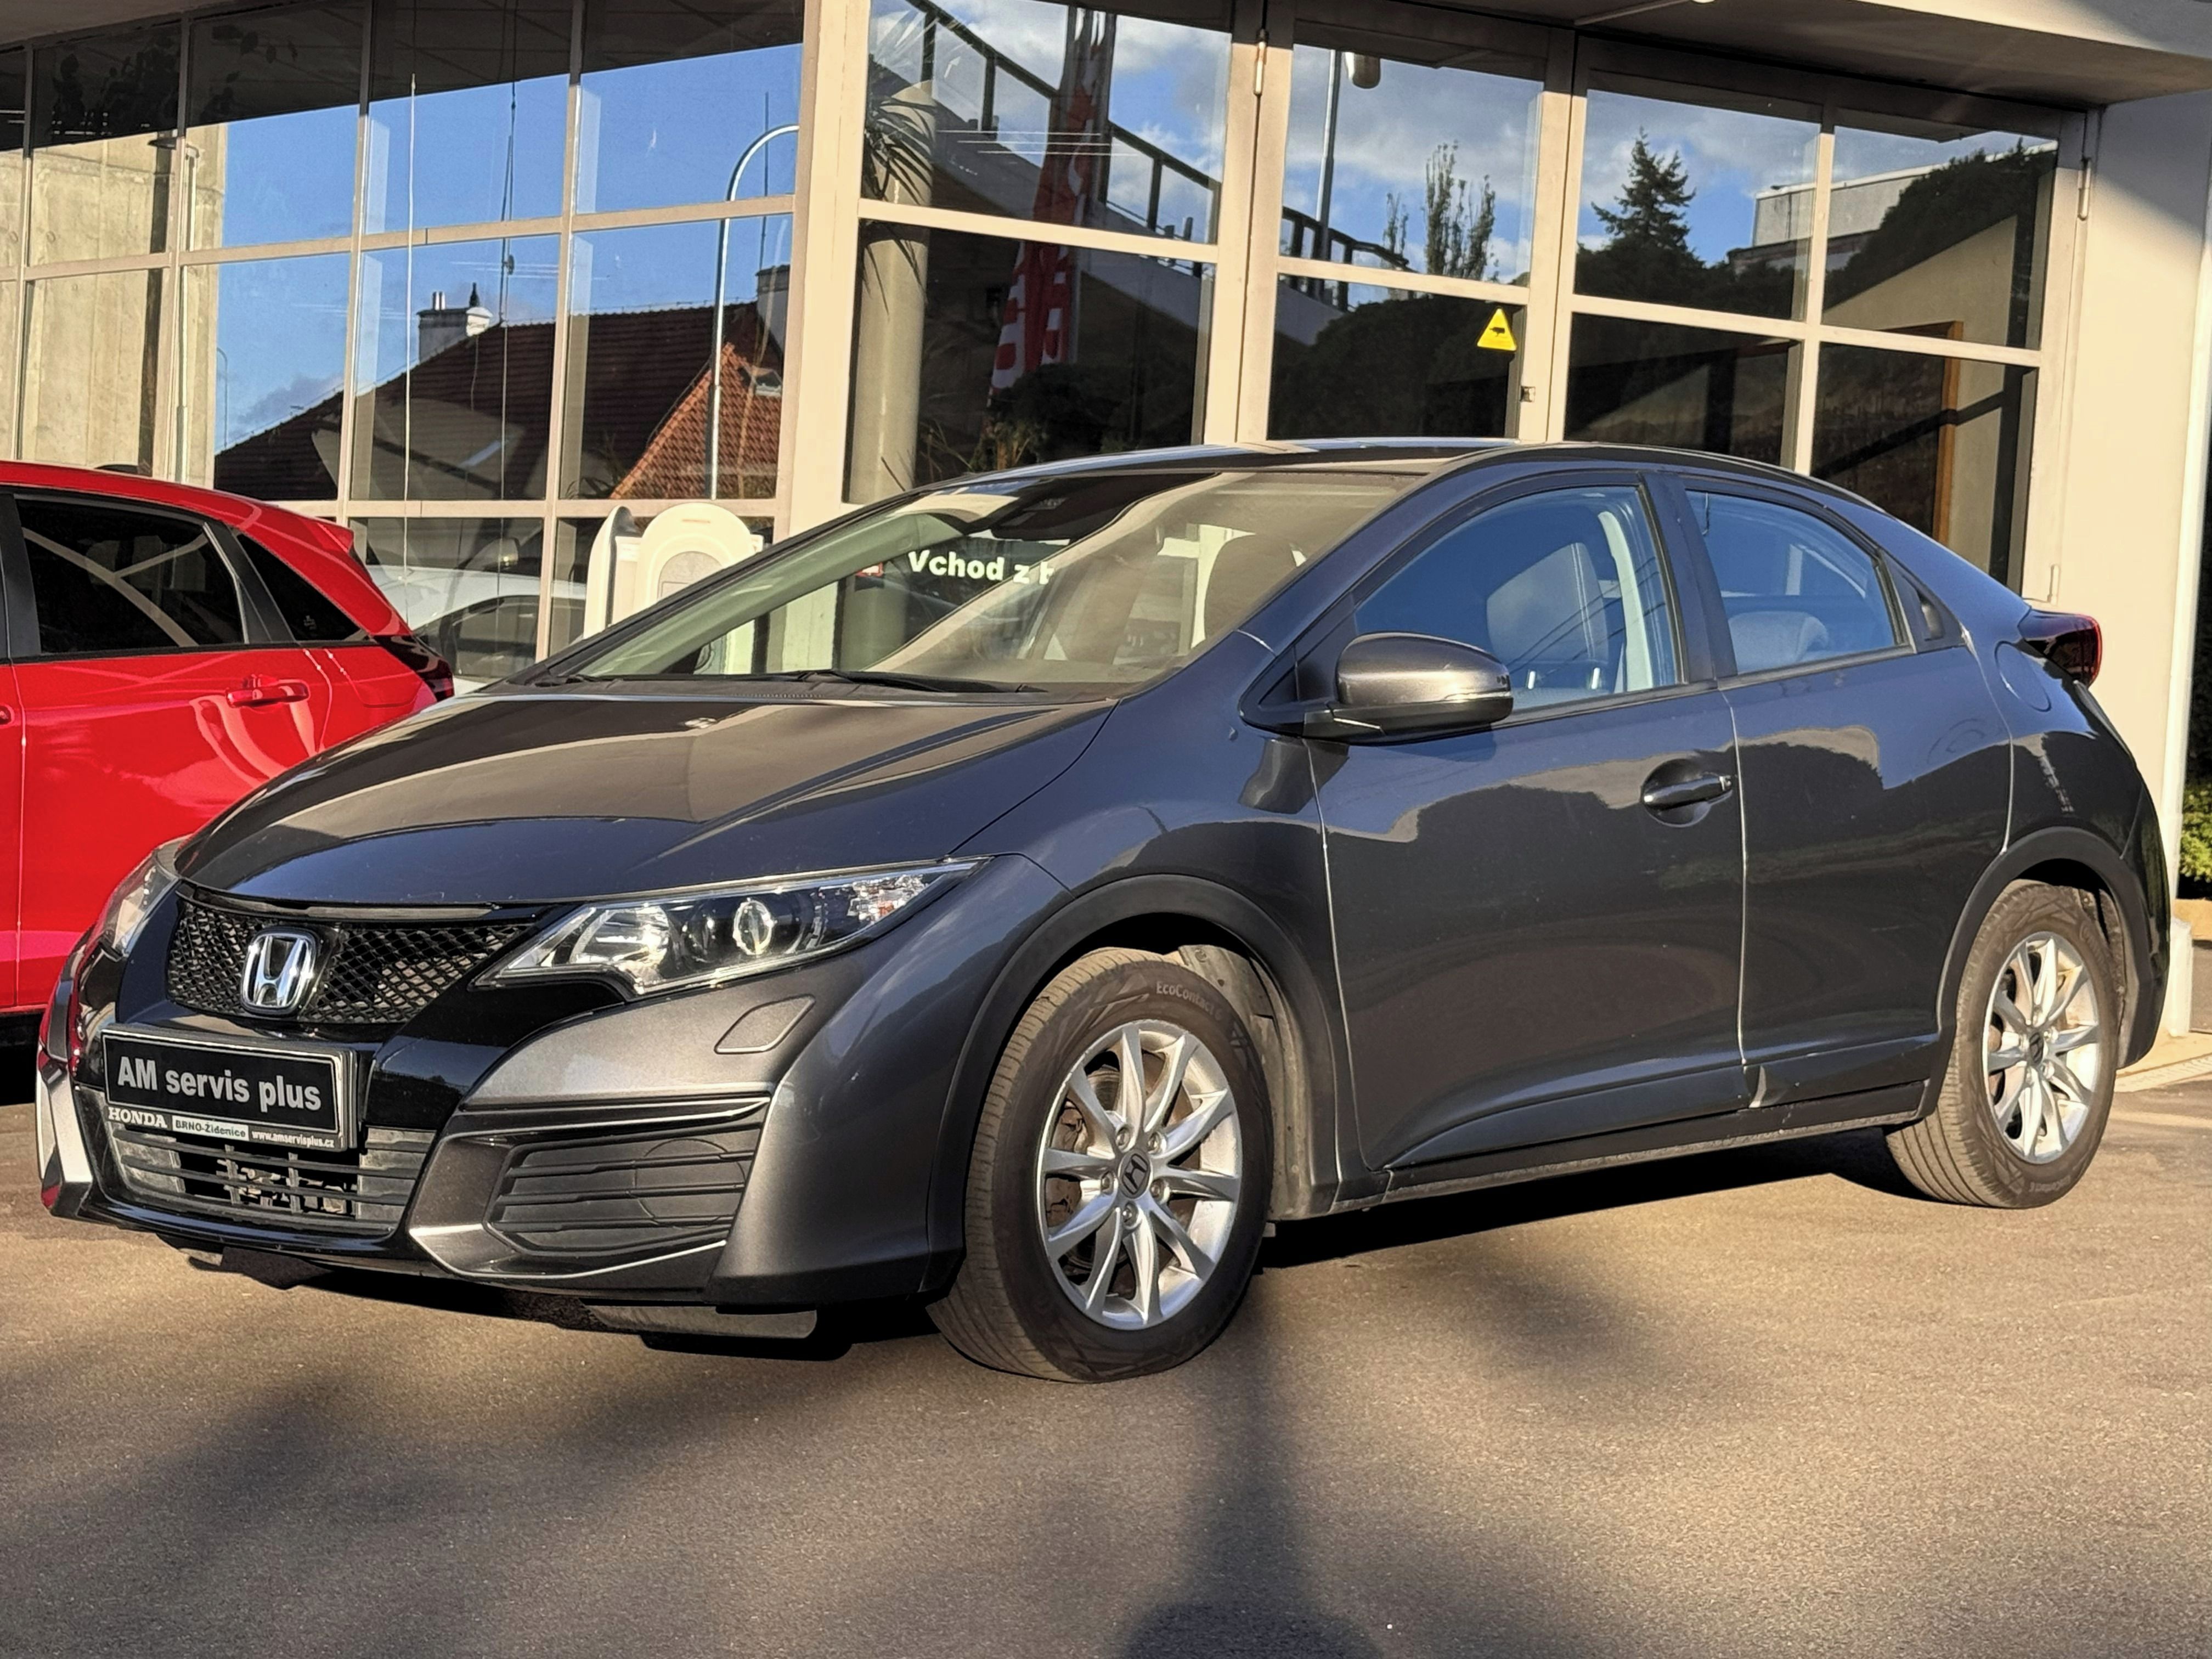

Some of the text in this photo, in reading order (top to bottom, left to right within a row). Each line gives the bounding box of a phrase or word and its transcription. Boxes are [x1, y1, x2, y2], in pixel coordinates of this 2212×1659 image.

[908, 549, 1005, 580] Vchod
[1013, 564, 1030, 584] z
[1155, 980, 1215, 1016] EcoContact
[117, 1056, 321, 1113] AM servis plus
[108, 1107, 167, 1128] HONDA
[252, 1131, 335, 1148] www.amservisplus.cz
